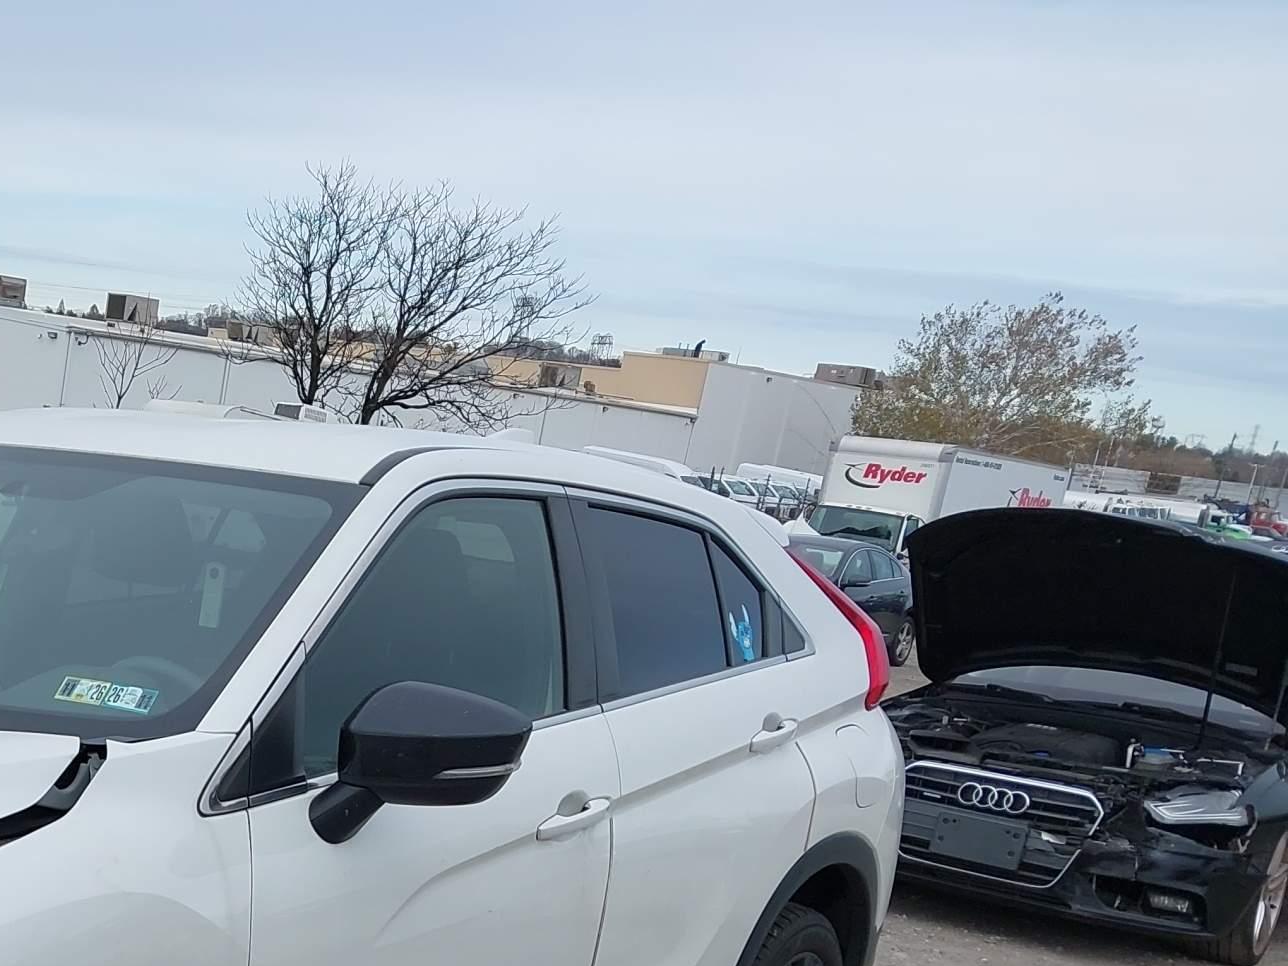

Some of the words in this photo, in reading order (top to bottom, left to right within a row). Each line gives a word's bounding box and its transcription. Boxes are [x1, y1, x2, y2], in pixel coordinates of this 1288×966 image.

[863, 463, 928, 483] Ryder
[90, 684, 108, 701] 26
[107, 686, 125, 704] 26
